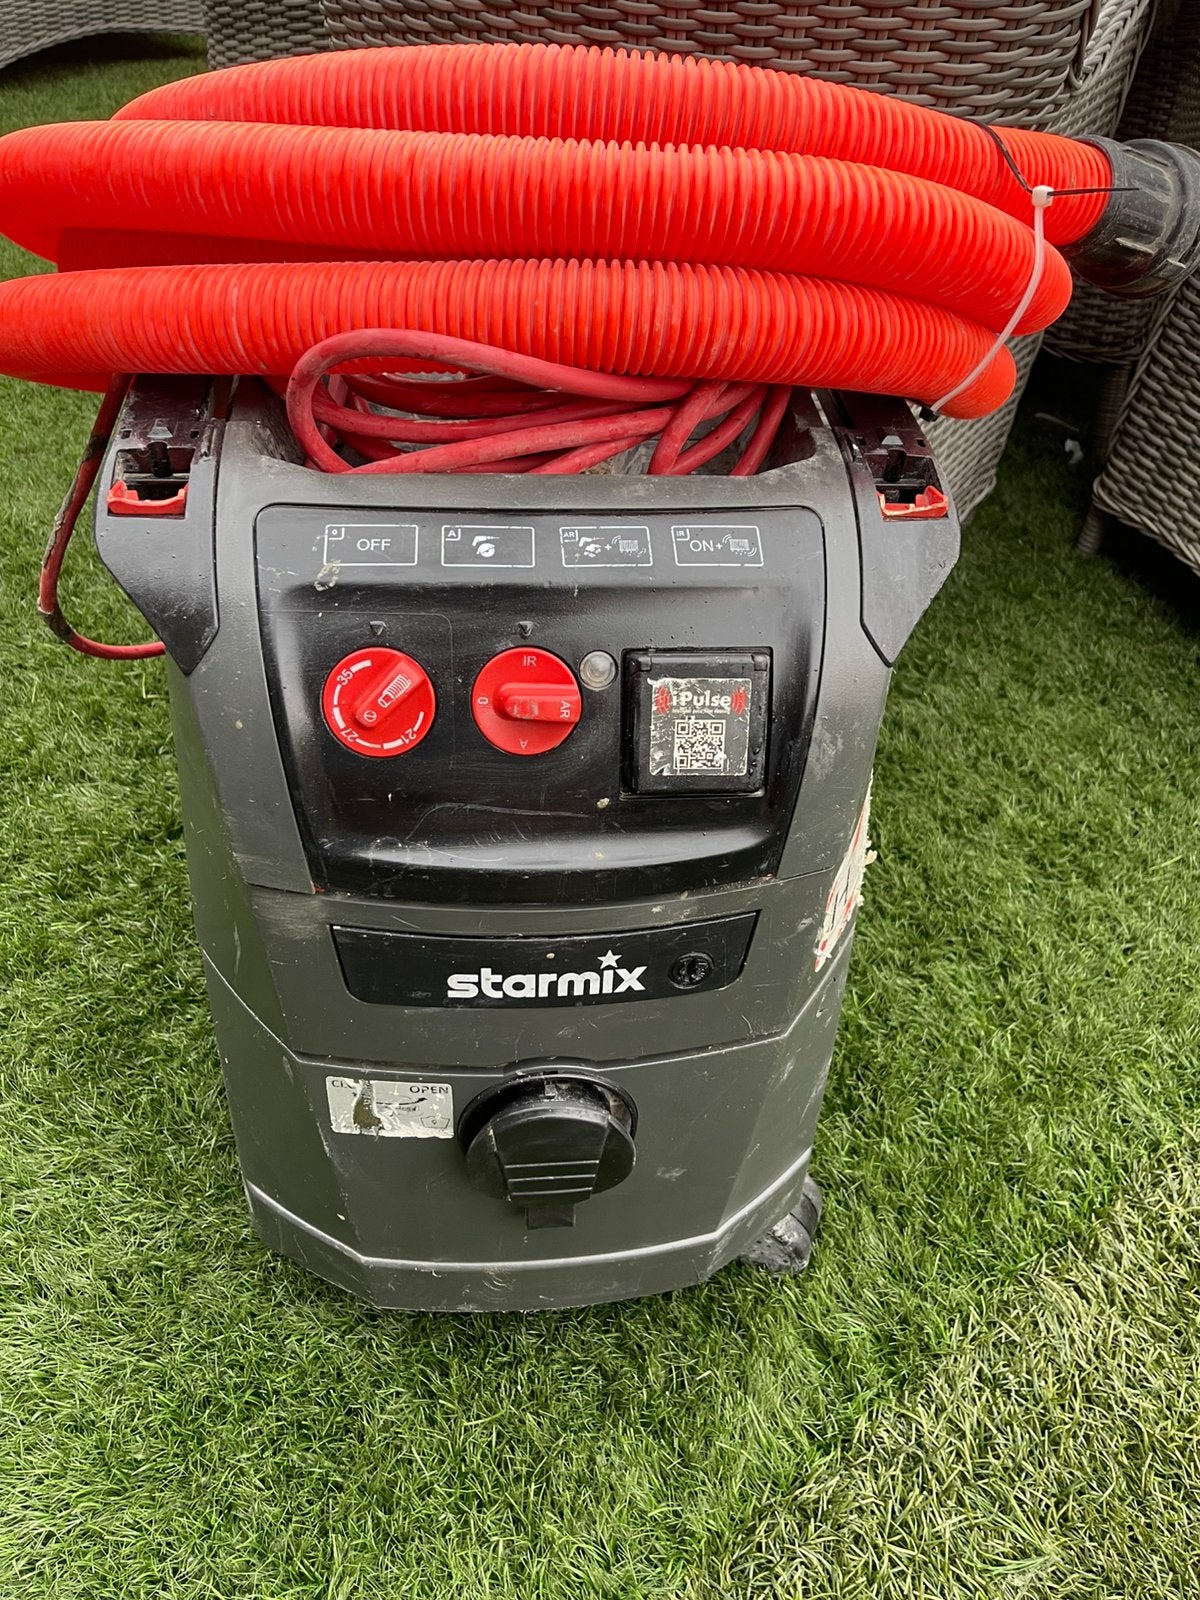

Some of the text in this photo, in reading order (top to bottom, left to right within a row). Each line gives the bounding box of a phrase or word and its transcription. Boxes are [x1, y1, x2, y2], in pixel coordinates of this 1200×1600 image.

[447, 529, 457, 538] A
[562, 531, 576, 539] AR
[675, 530, 686, 538] IR
[356, 538, 392, 551] OFF
[523, 655, 537, 667] IR
[336, 668, 354, 686] 35
[559, 700, 571, 719] AR
[340, 727, 359, 743] 27
[399, 727, 417, 745] 21
[519, 738, 529, 749] A
[447, 950, 648, 999] starmix
[409, 1085, 449, 1095] OPEN
